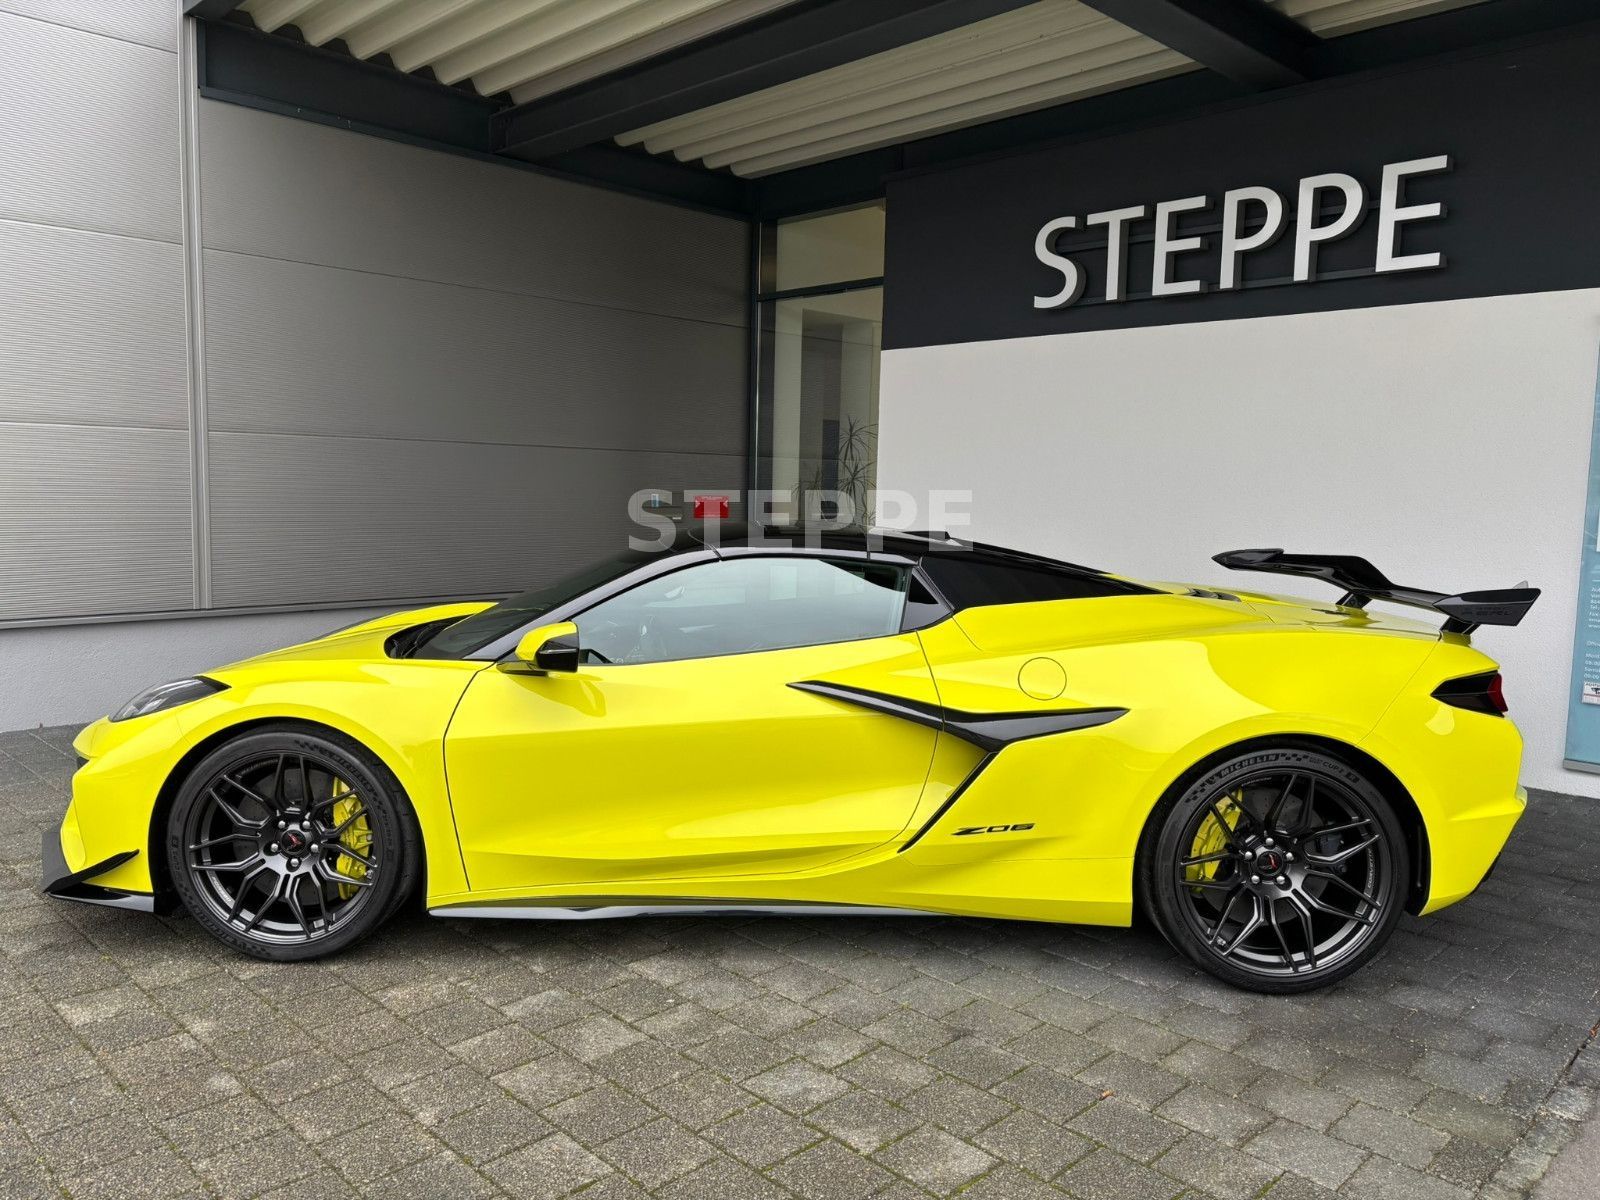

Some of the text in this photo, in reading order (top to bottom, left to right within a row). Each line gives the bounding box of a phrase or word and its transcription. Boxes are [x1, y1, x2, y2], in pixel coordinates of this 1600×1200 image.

[1033, 154, 1449, 309] STEPPE
[1219, 753, 1280, 779] MICHELIN
[951, 823, 1036, 836] Z06
